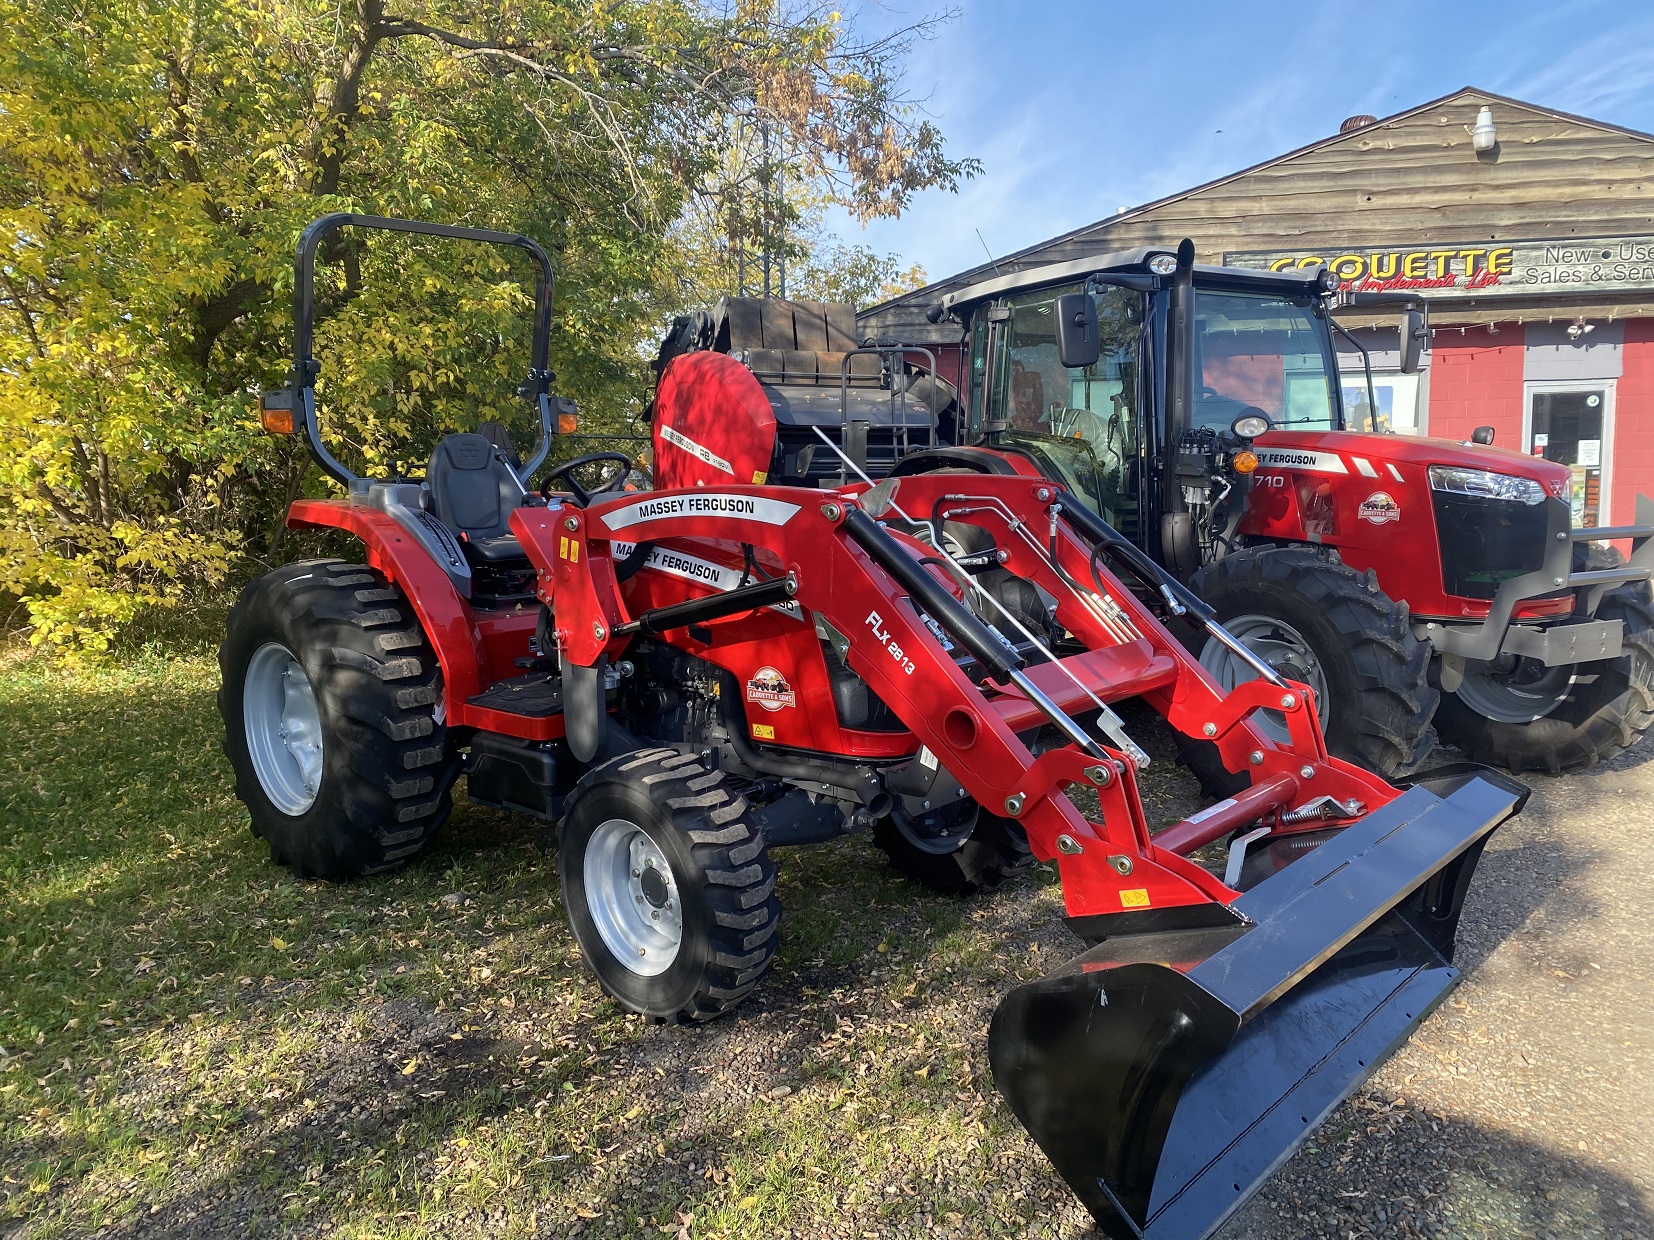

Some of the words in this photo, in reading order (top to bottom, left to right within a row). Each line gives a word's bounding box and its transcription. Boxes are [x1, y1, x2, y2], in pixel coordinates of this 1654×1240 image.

[1545, 246, 1592, 264] New
[1357, 271, 1457, 292] Implements
[1465, 266, 1503, 289] Ltd.
[1525, 267, 1582, 285] Sales
[1590, 264, 1605, 282] &
[1269, 454, 1317, 465] FERGUSON
[638, 500, 685, 518] MASSEY
[689, 498, 754, 514] FERGUSON
[616, 542, 660, 563] MAEY
[661, 554, 720, 583] FERGUSON
[887, 641, 916, 675] 2813
[779, 694, 792, 702] SONS
